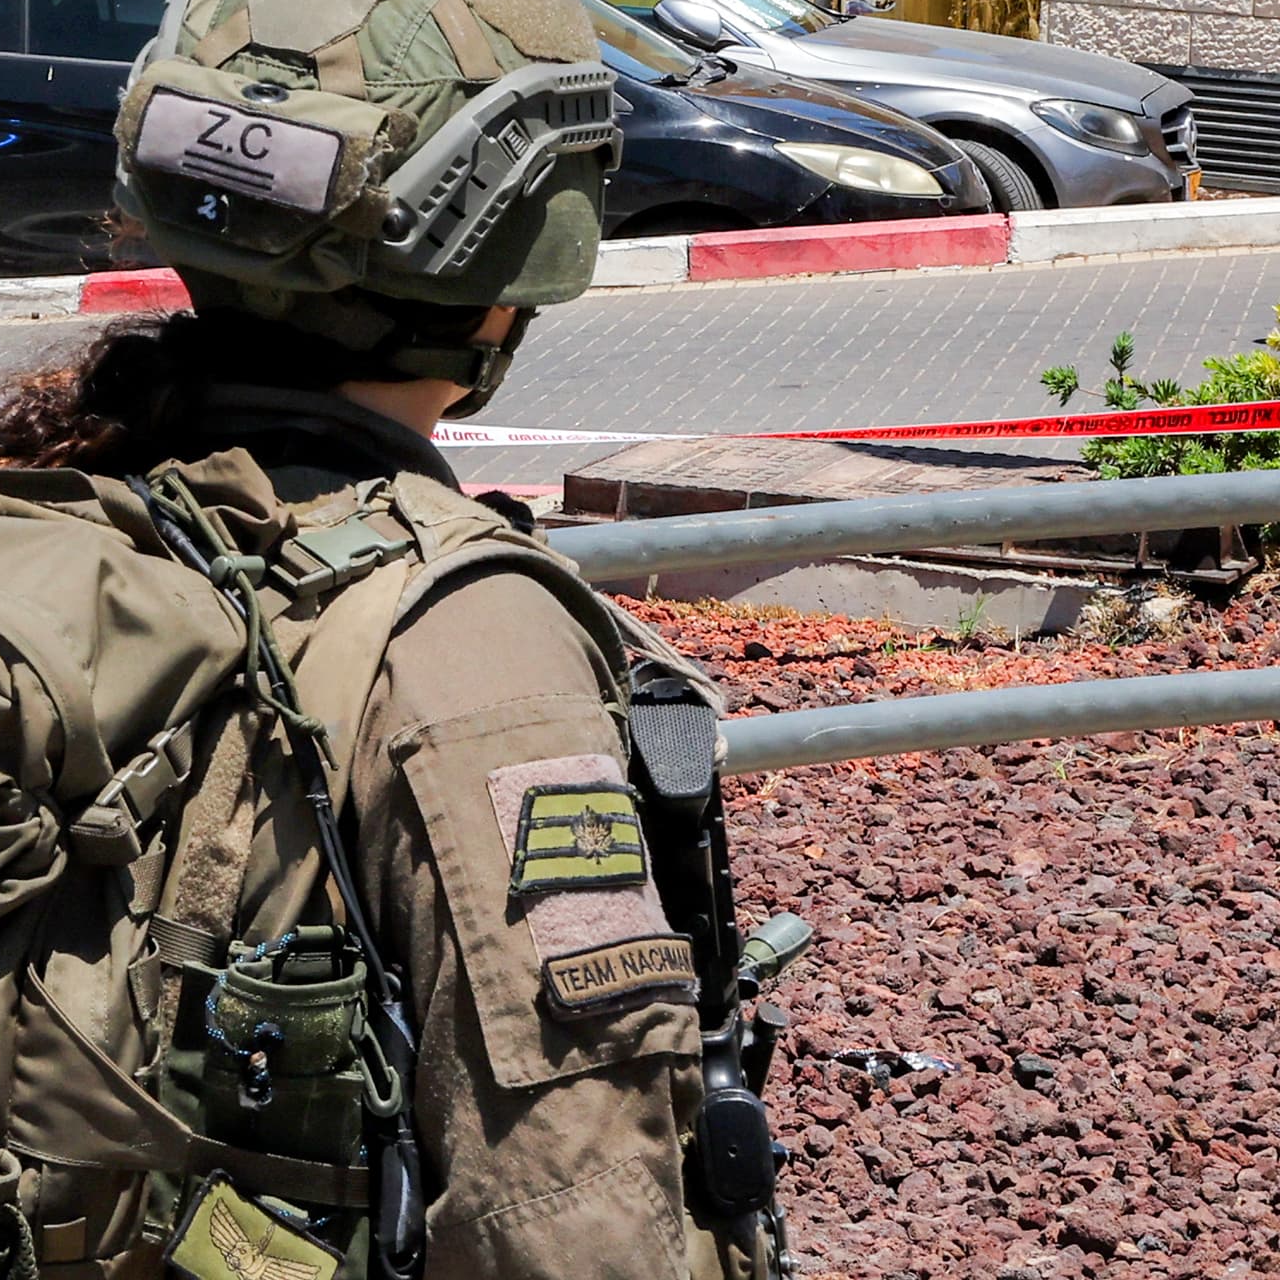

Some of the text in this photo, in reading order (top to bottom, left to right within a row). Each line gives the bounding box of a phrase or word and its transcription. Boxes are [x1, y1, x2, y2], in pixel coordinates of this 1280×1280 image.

[196, 109, 273, 161] Z.C
[555, 945, 690, 993] TEAM NACHMAN
